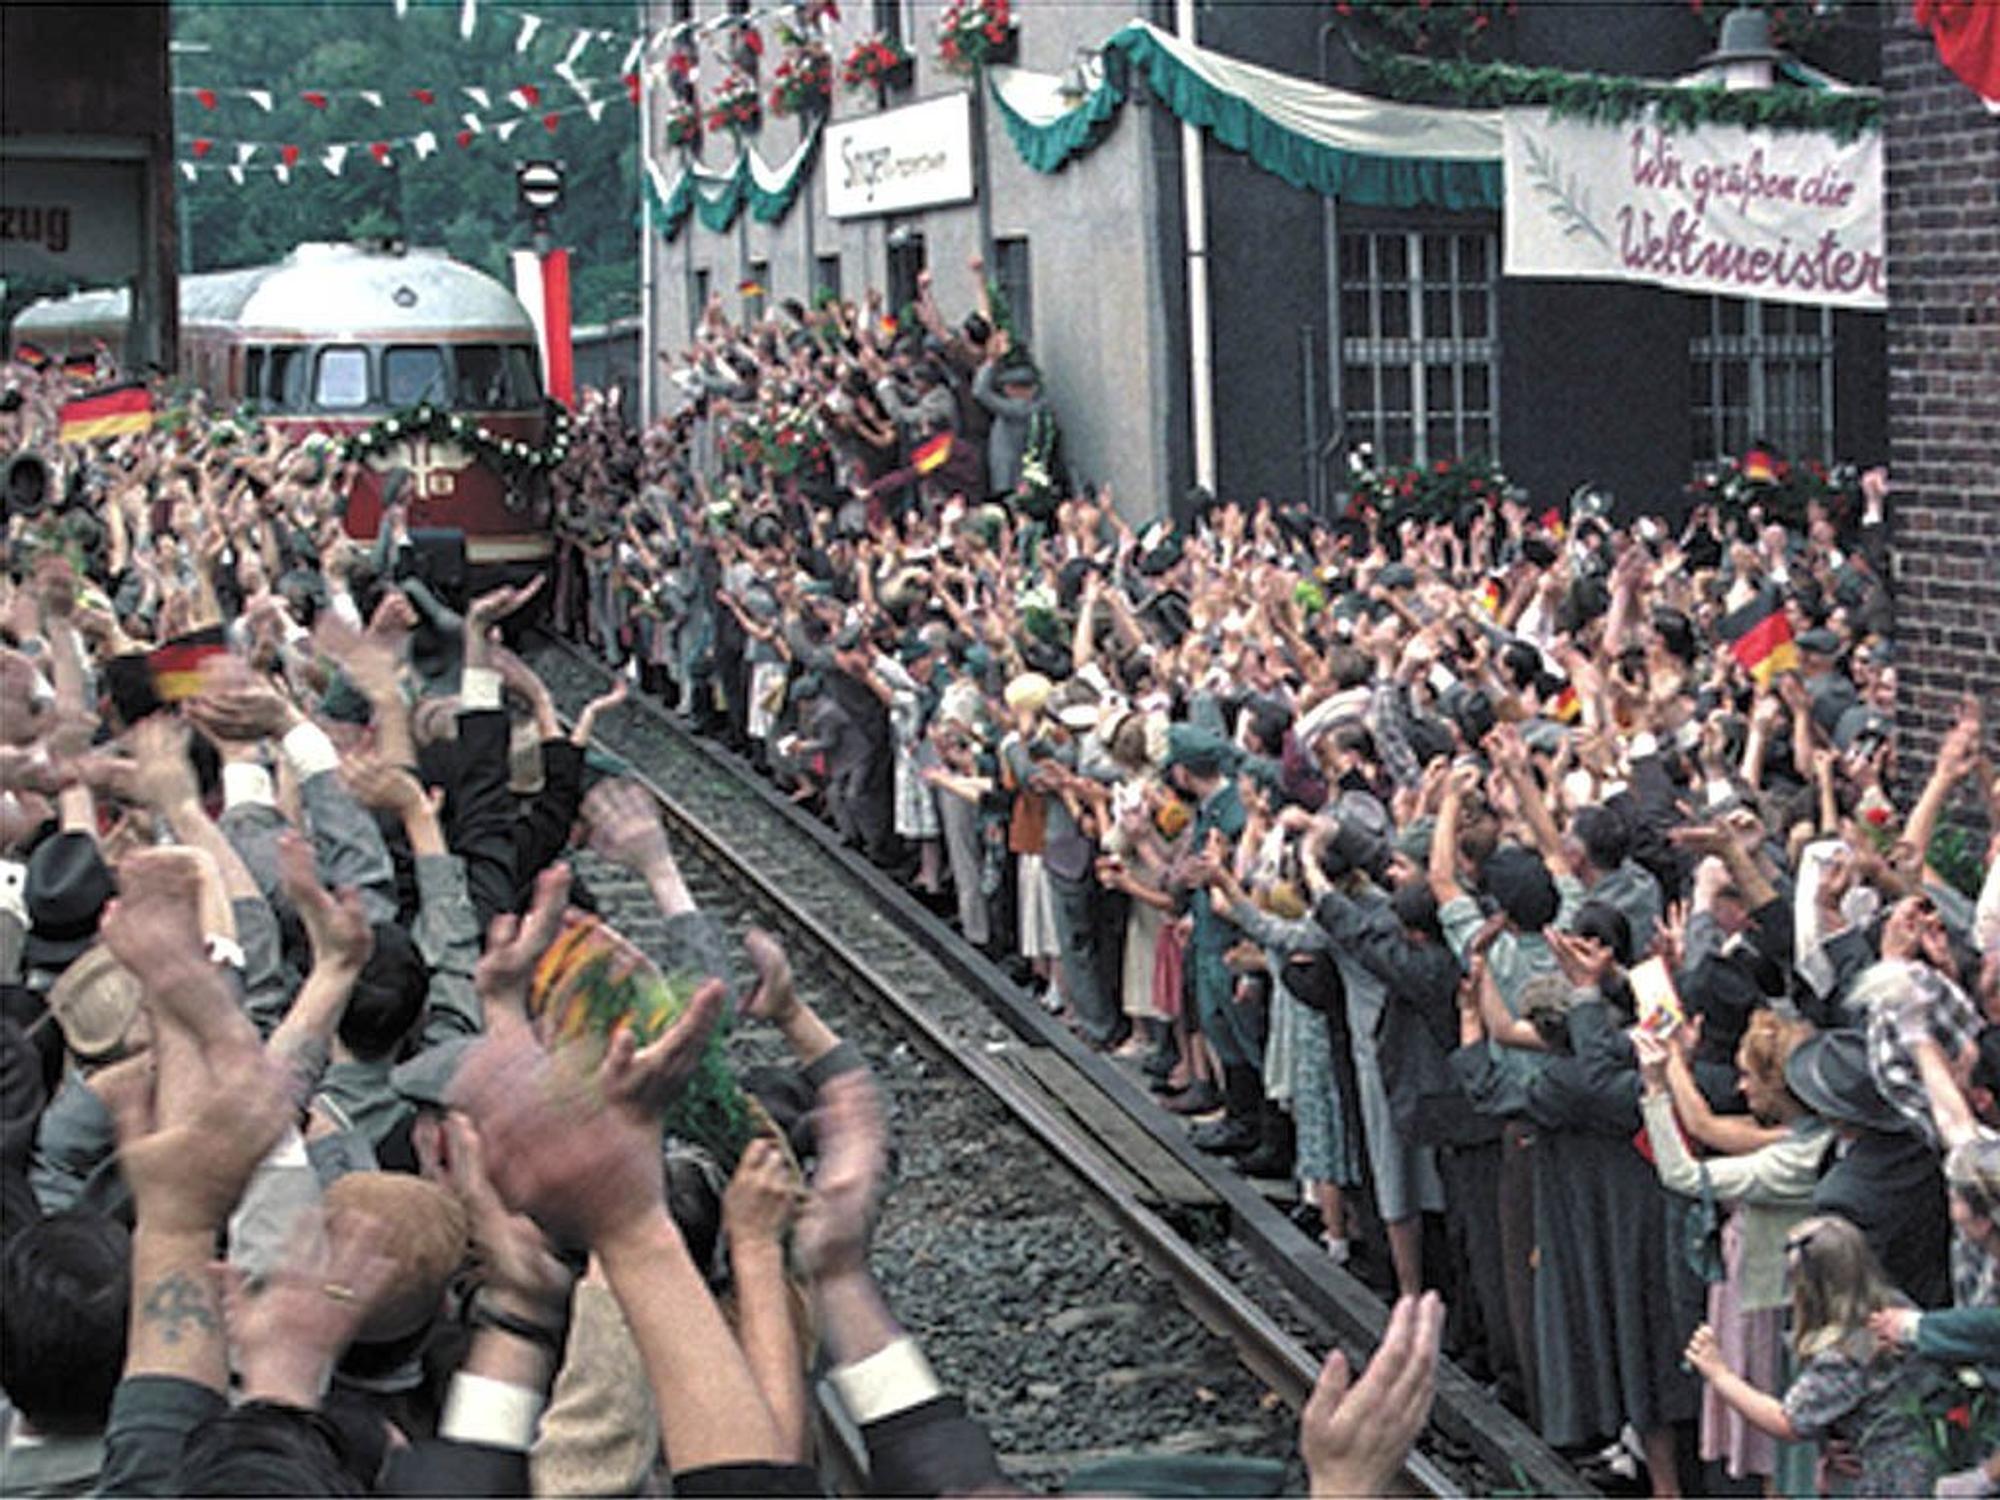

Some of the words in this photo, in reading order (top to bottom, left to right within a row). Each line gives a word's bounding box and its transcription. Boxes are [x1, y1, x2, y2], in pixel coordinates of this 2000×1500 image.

[1630, 127, 1686, 190] Wir
[1691, 148, 1797, 216] grüßen
[1801, 163, 1855, 207] die
[0, 206, 70, 253] zug
[1616, 203, 1886, 294] Weltmeister
